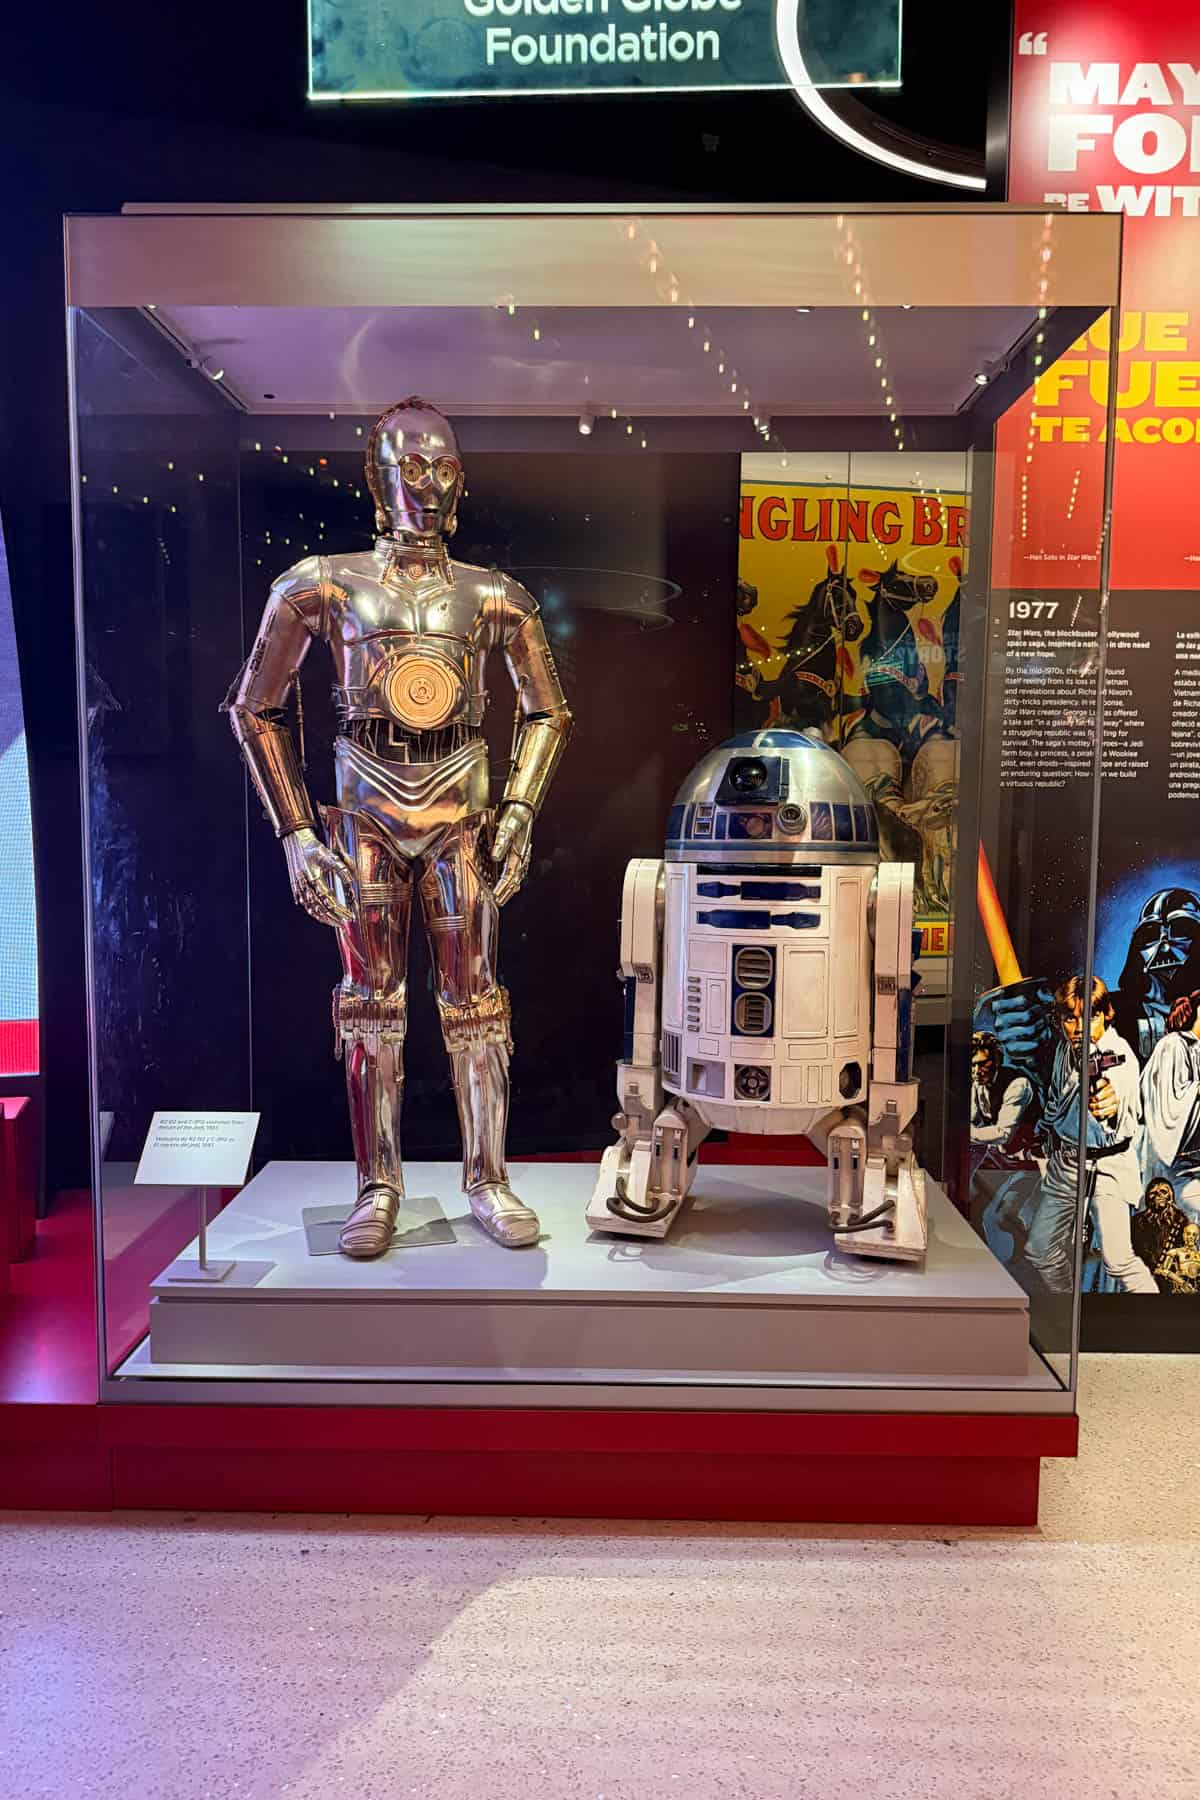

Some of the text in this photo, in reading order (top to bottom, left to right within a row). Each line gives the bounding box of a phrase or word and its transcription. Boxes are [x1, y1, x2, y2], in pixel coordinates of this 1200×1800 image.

[485, 22, 720, 65] Foundation
[1049, 62, 1200, 105] MAY
[1047, 112, 1200, 174] FO
[1034, 359, 1200, 409] FUE
[1031, 416, 1200, 444] TE ACO
[1009, 601, 1059, 619] 1977
[1048, 640, 1076, 648] inspired
[1117, 640, 1132, 648] dire
[1088, 730, 1117, 738] figting
